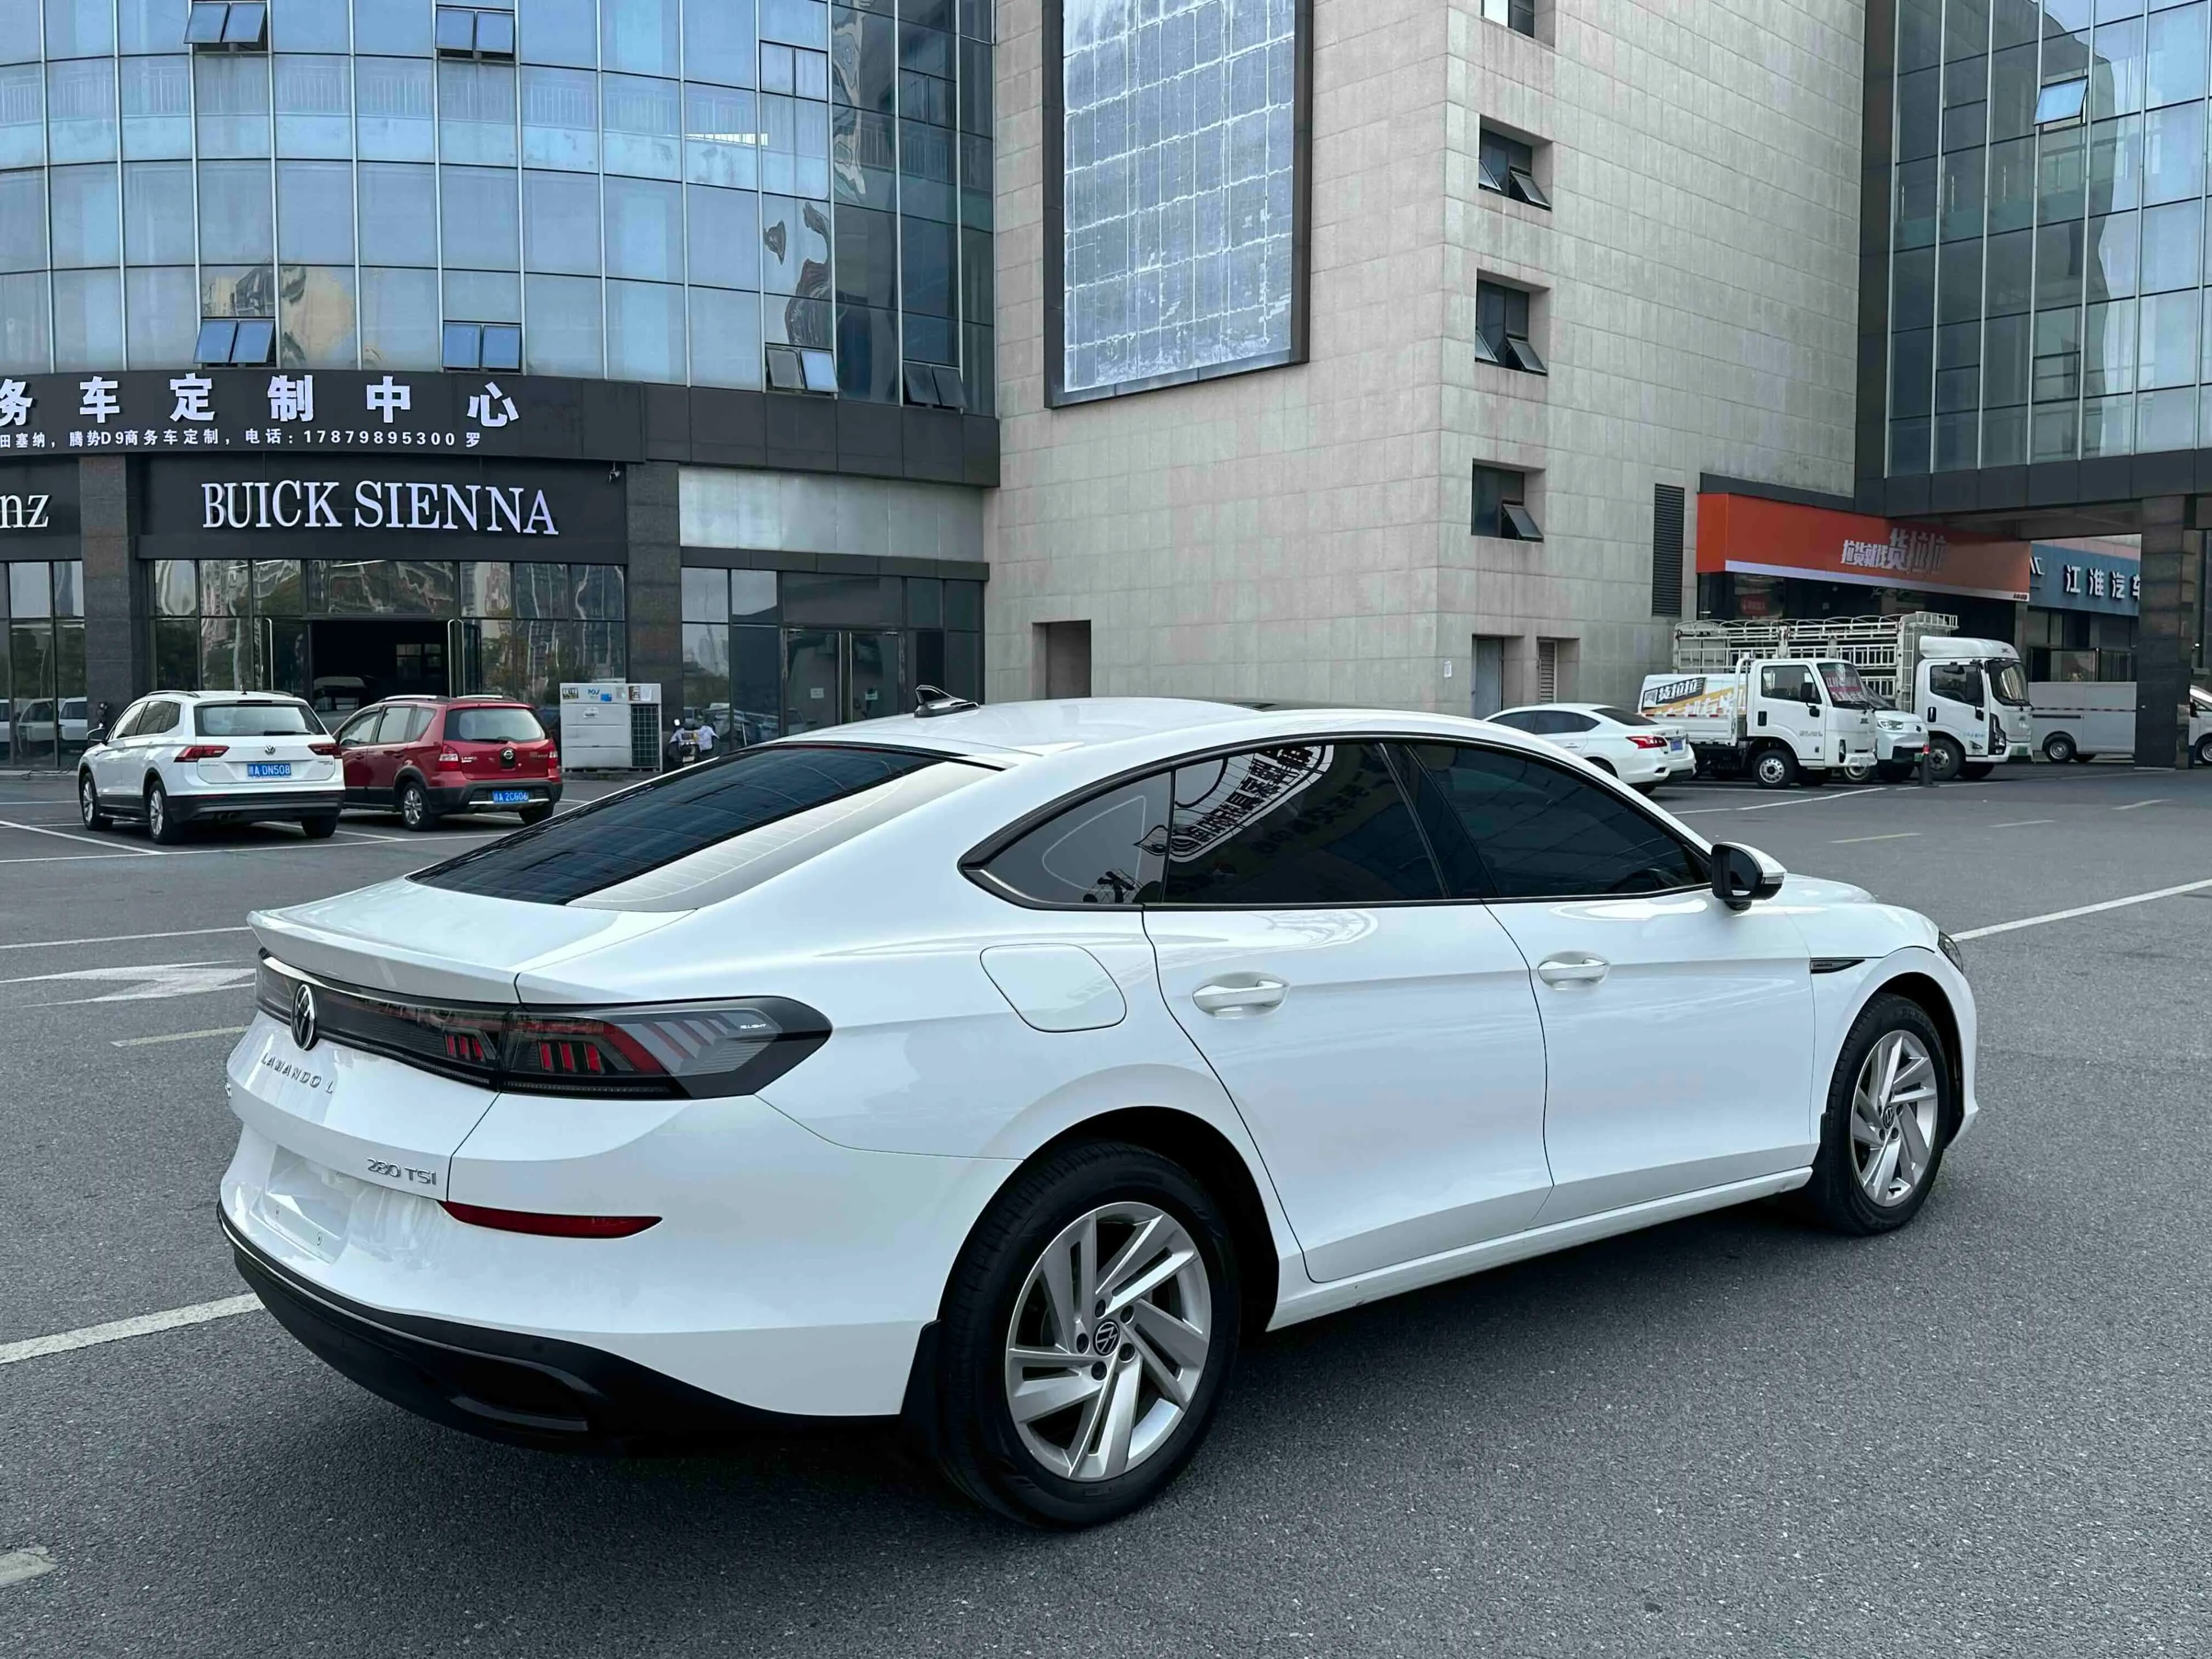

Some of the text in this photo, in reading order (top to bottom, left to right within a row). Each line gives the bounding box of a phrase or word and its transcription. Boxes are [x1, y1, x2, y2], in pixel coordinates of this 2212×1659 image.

[0, 373, 520, 427] 务车定制中心
[465, 431, 480, 448] 罗
[202, 480, 559, 535] BUICK SIENNA
[325, 1080, 334, 1094] L
[367, 1157, 437, 1185] 280 TSI
